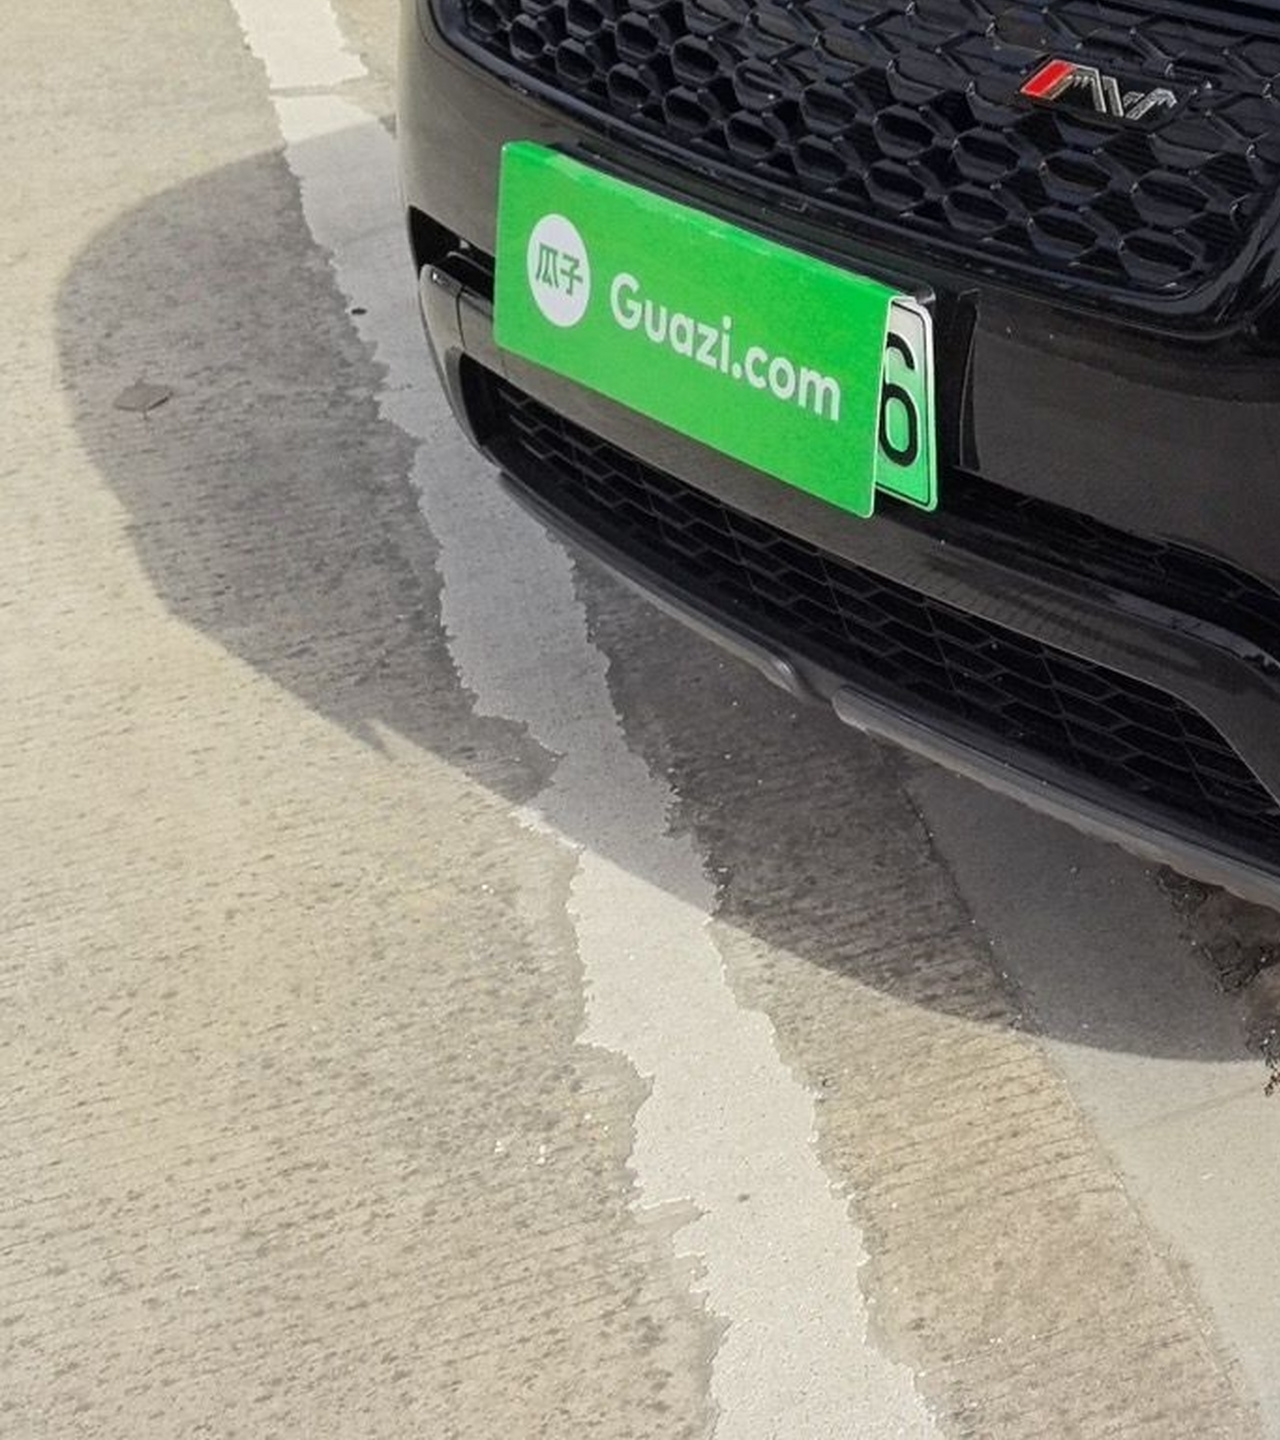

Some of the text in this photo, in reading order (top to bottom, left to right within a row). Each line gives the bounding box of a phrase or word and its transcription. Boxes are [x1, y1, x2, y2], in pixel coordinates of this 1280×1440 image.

[535, 242, 584, 297] 瓜子
[610, 272, 841, 422] Guazi.com
[879, 331, 919, 468] 6
